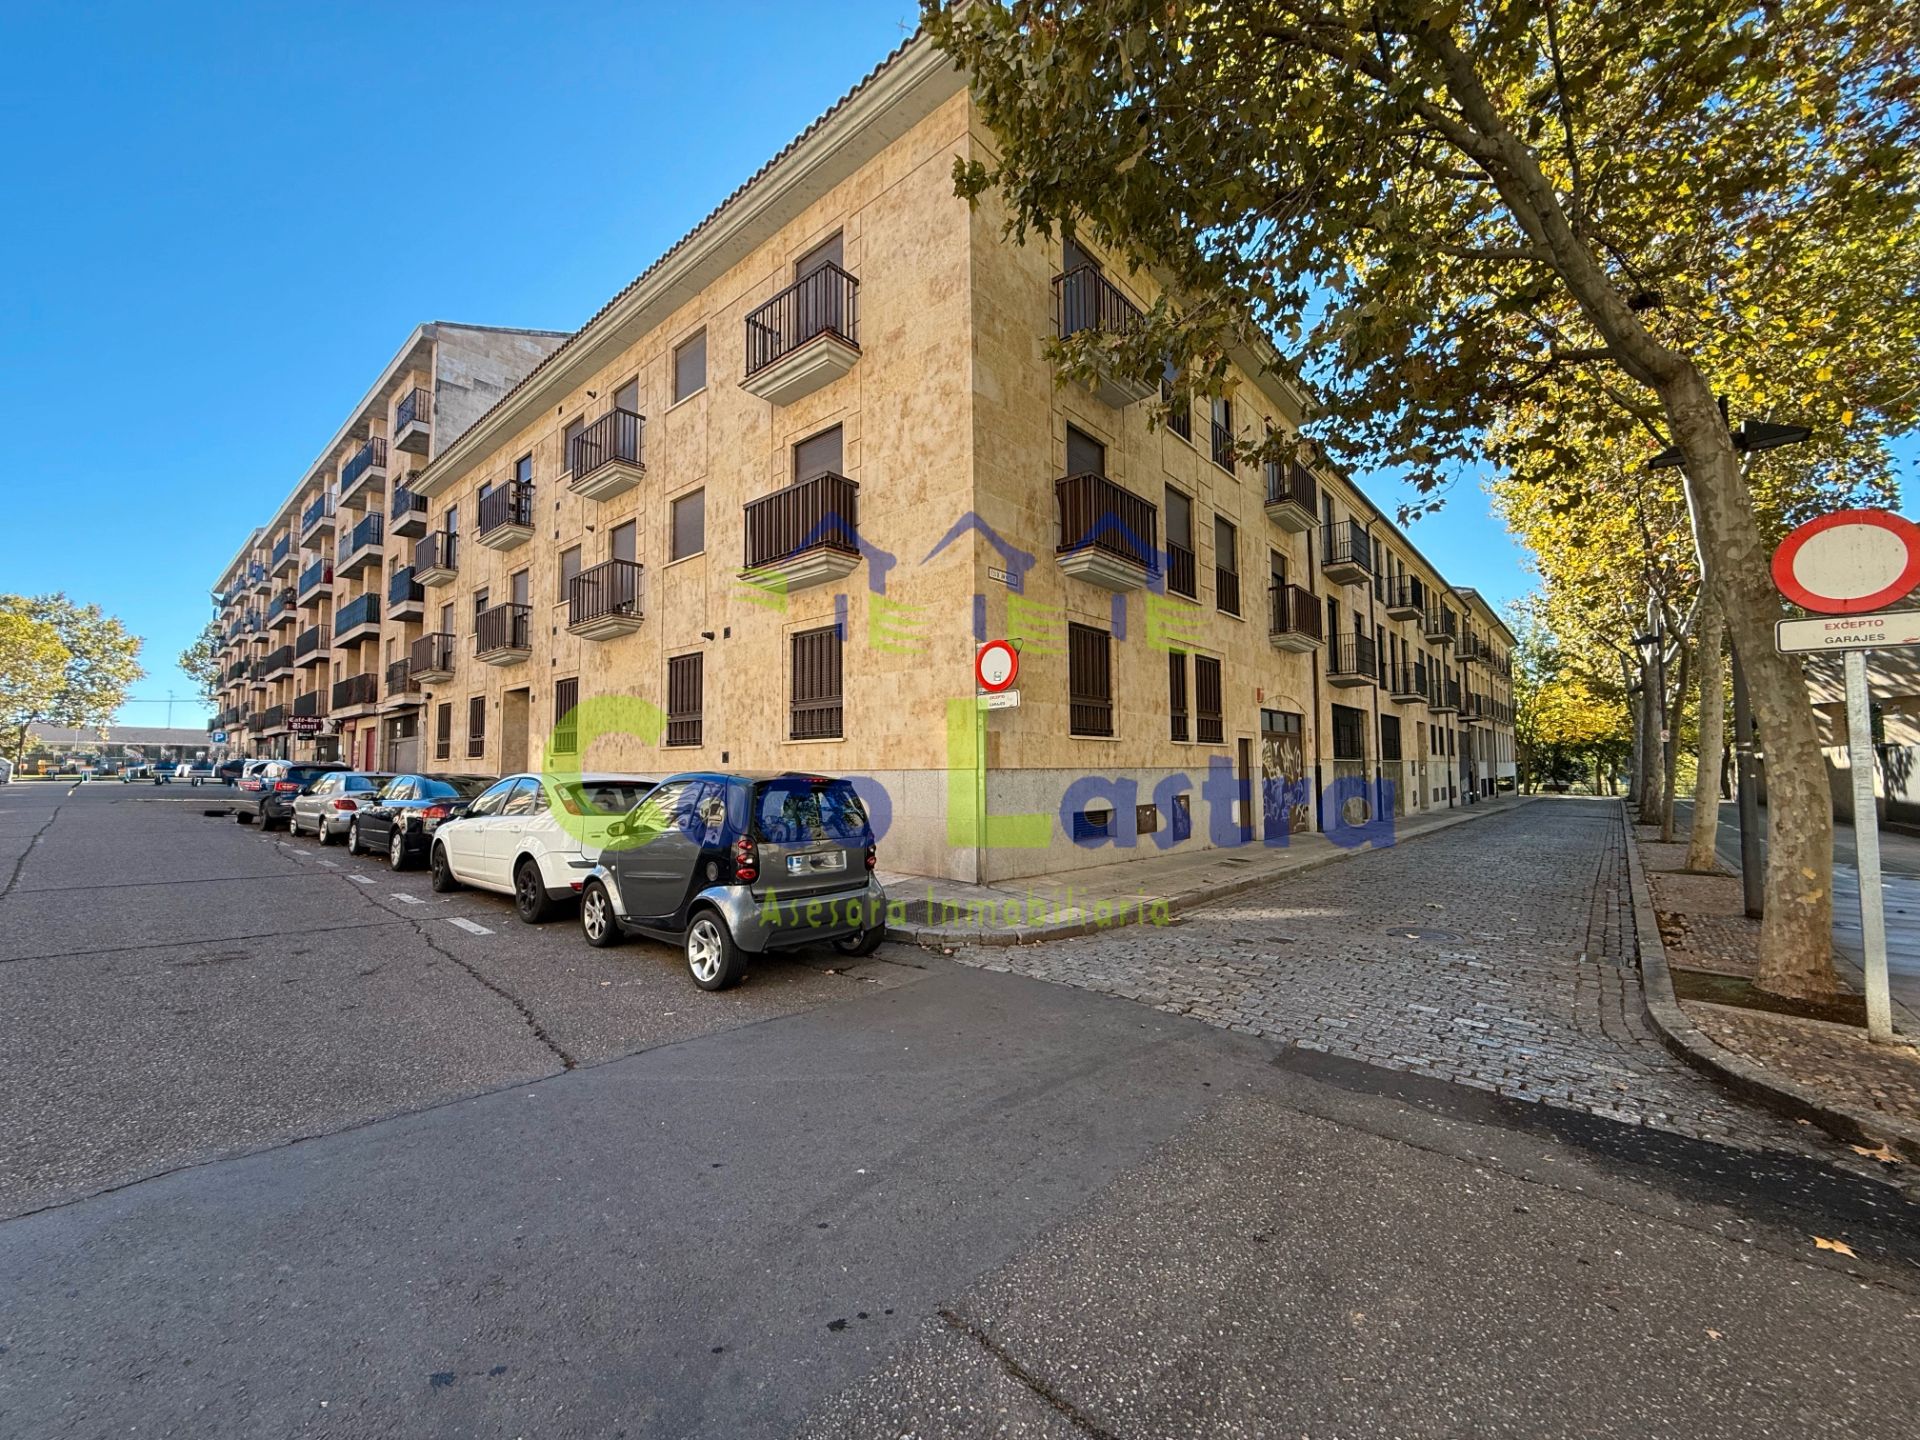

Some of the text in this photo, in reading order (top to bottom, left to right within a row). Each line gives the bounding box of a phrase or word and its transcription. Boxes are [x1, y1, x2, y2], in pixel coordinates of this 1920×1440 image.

[1824, 619, 1884, 631] EXCEPTO
[1824, 633, 1886, 644] GARAJES
[214, 733, 223, 741] P
